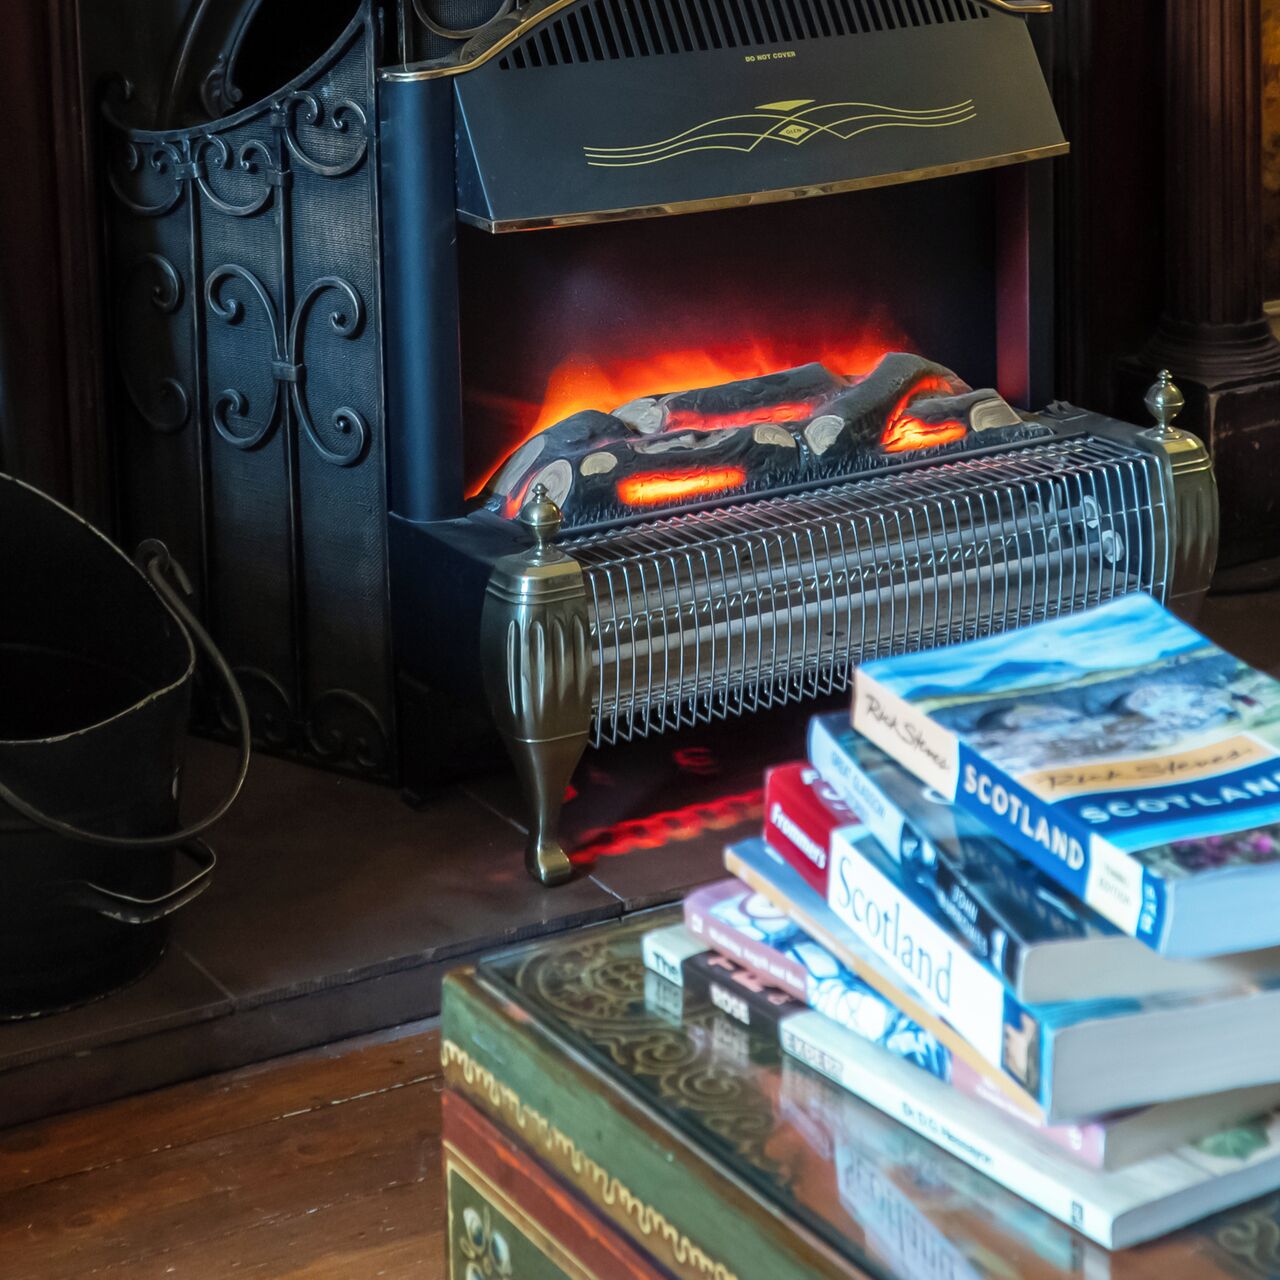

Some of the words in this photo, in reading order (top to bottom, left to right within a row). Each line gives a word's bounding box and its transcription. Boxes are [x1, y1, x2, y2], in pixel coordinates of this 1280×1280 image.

[757, 53, 771, 61] NOT
[773, 51, 796, 59] COVER
[866, 693, 898, 730] Rick
[894, 722, 950, 769] Steves
[771, 802, 827, 870] Frommer's
[963, 764, 1085, 871] SCOTLAND
[838, 856, 953, 1007] Scotland
[653, 951, 680, 984] The
[710, 984, 750, 1025] ROSE
